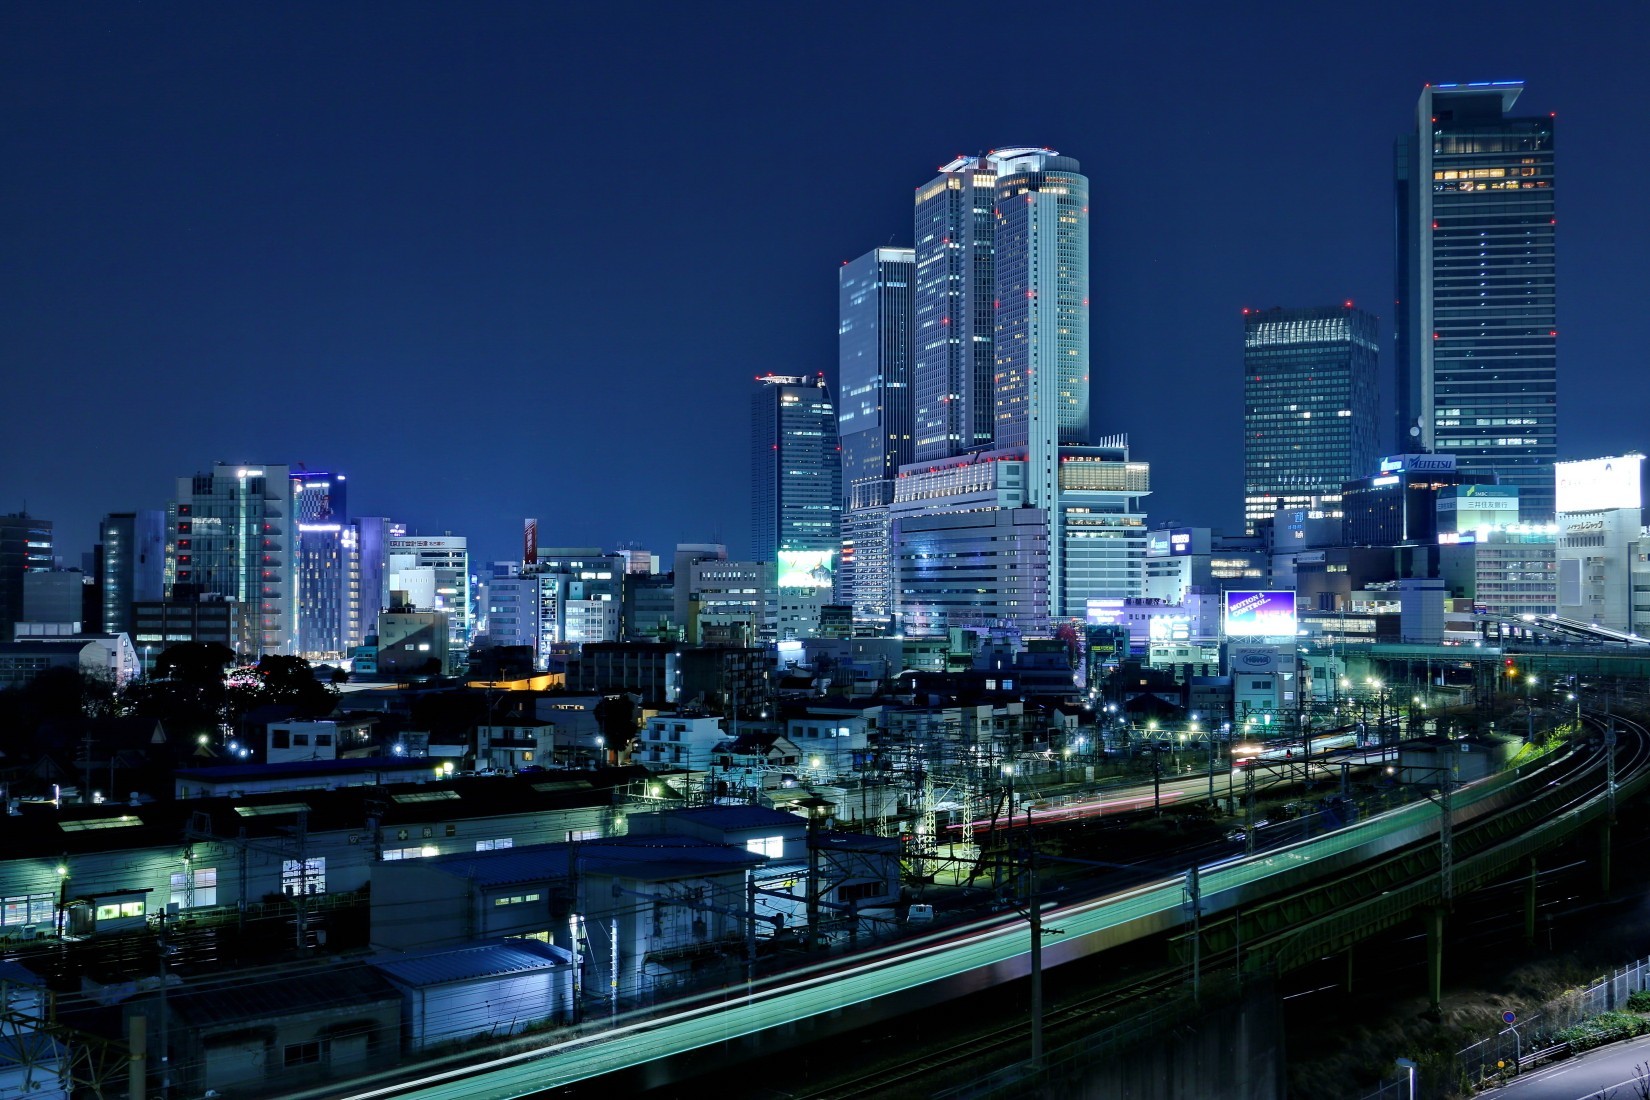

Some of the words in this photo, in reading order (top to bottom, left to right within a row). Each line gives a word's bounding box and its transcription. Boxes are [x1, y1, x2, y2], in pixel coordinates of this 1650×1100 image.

[1408, 456, 1452, 469] MEITETSU
[1468, 501, 1508, 509] 三井住友銀行
[1229, 594, 1259, 612] MOTION
